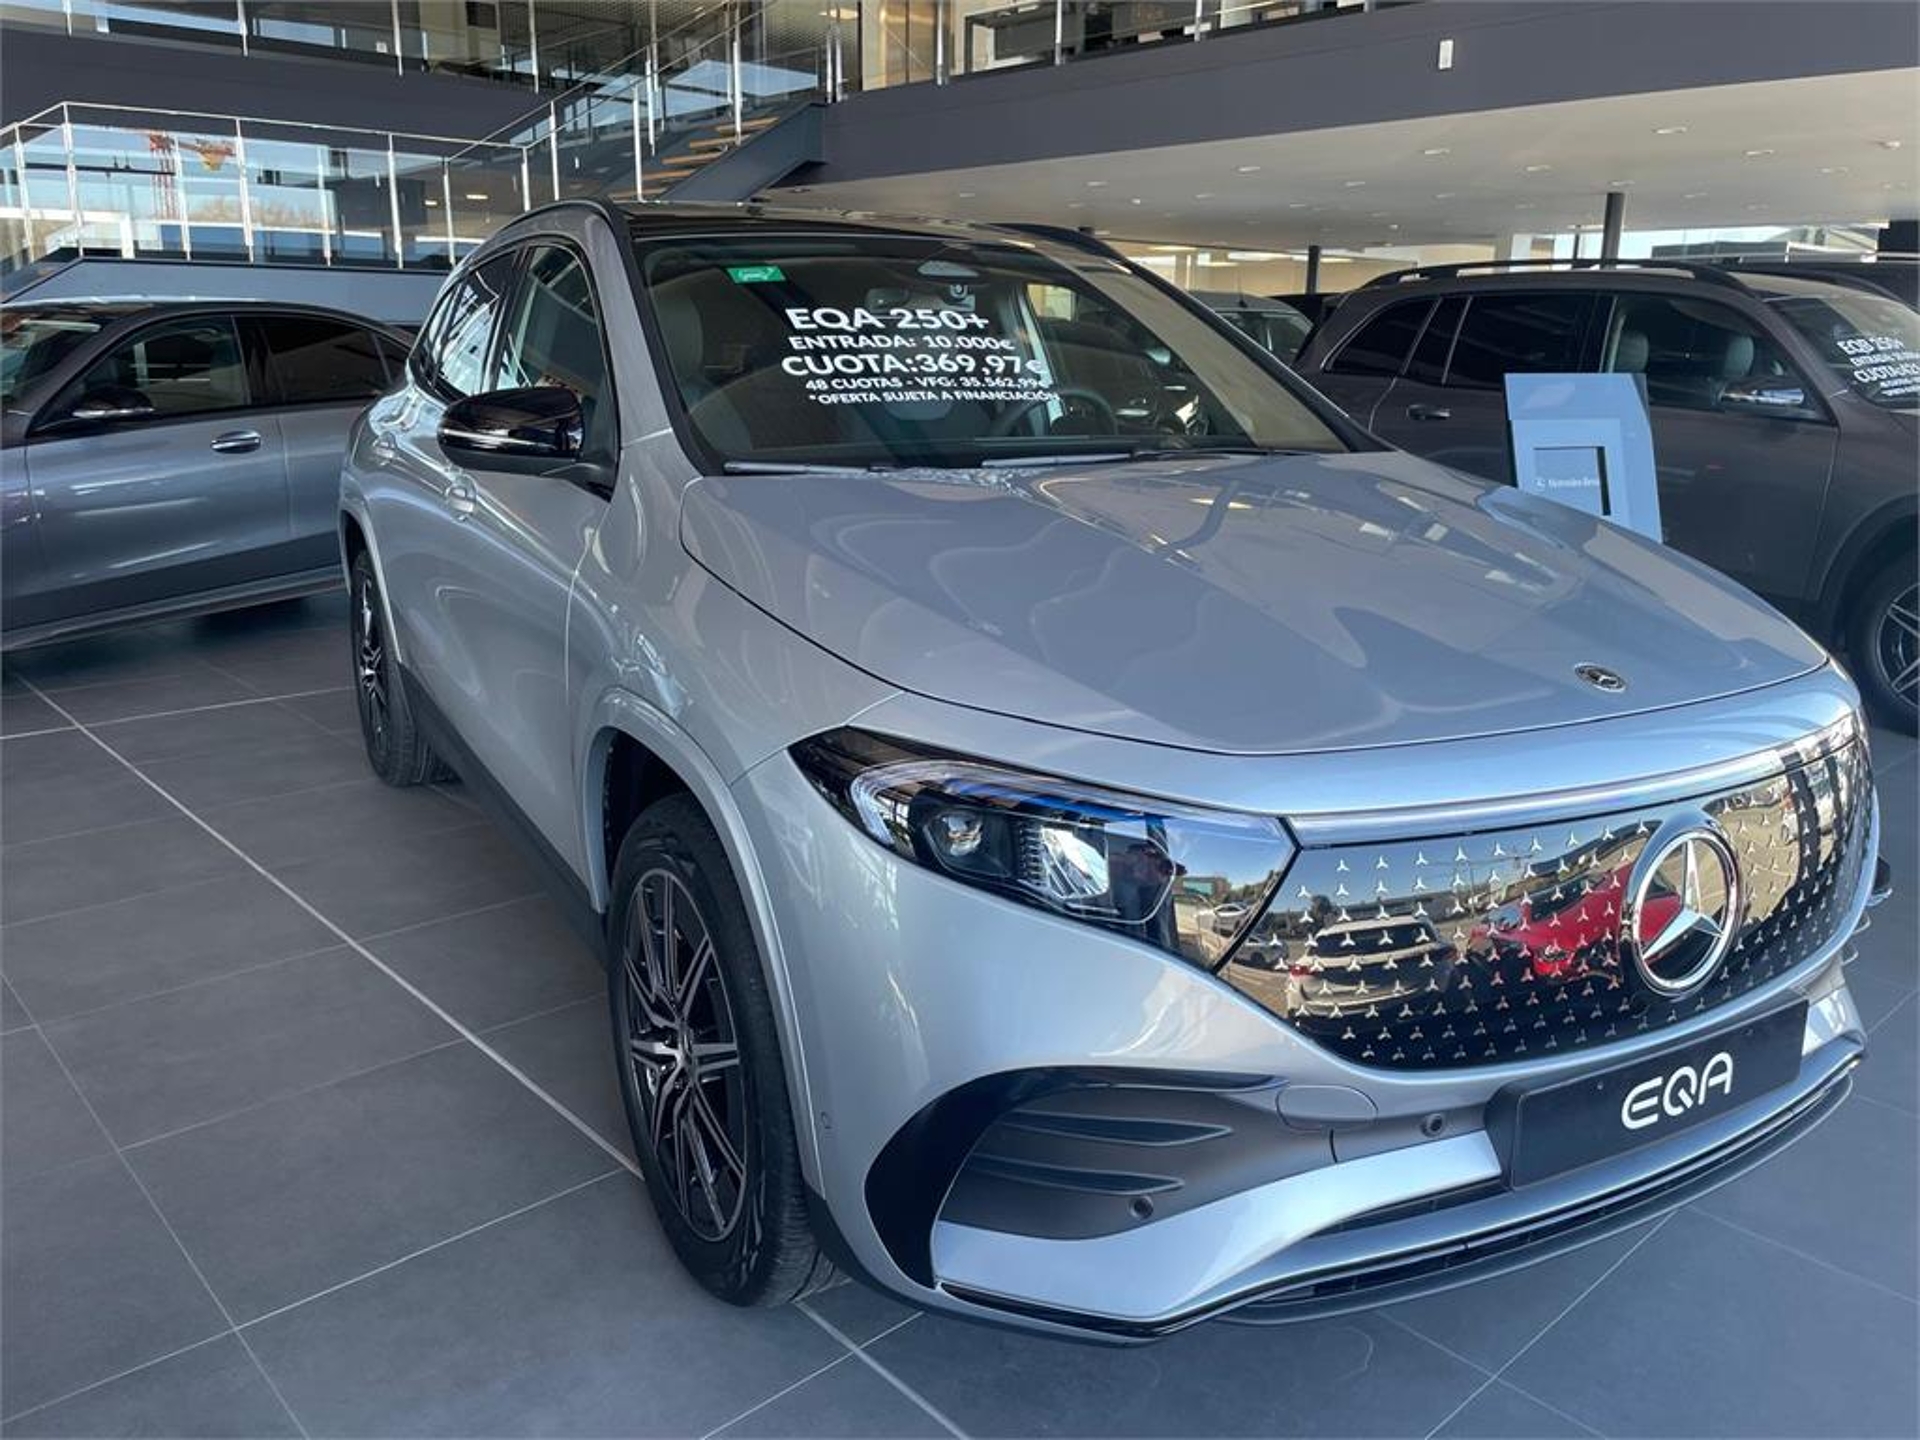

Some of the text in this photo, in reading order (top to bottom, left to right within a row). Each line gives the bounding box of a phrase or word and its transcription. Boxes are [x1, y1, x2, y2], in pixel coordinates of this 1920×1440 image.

[785, 308, 989, 331] EQA 250+
[789, 334, 1015, 350] ENTRADA: 10.000€
[805, 378, 829, 391] 48
[831, 377, 903, 389] CUOTAS
[883, 391, 939, 402] SUJETA
[1621, 1052, 1734, 1130] EQA
